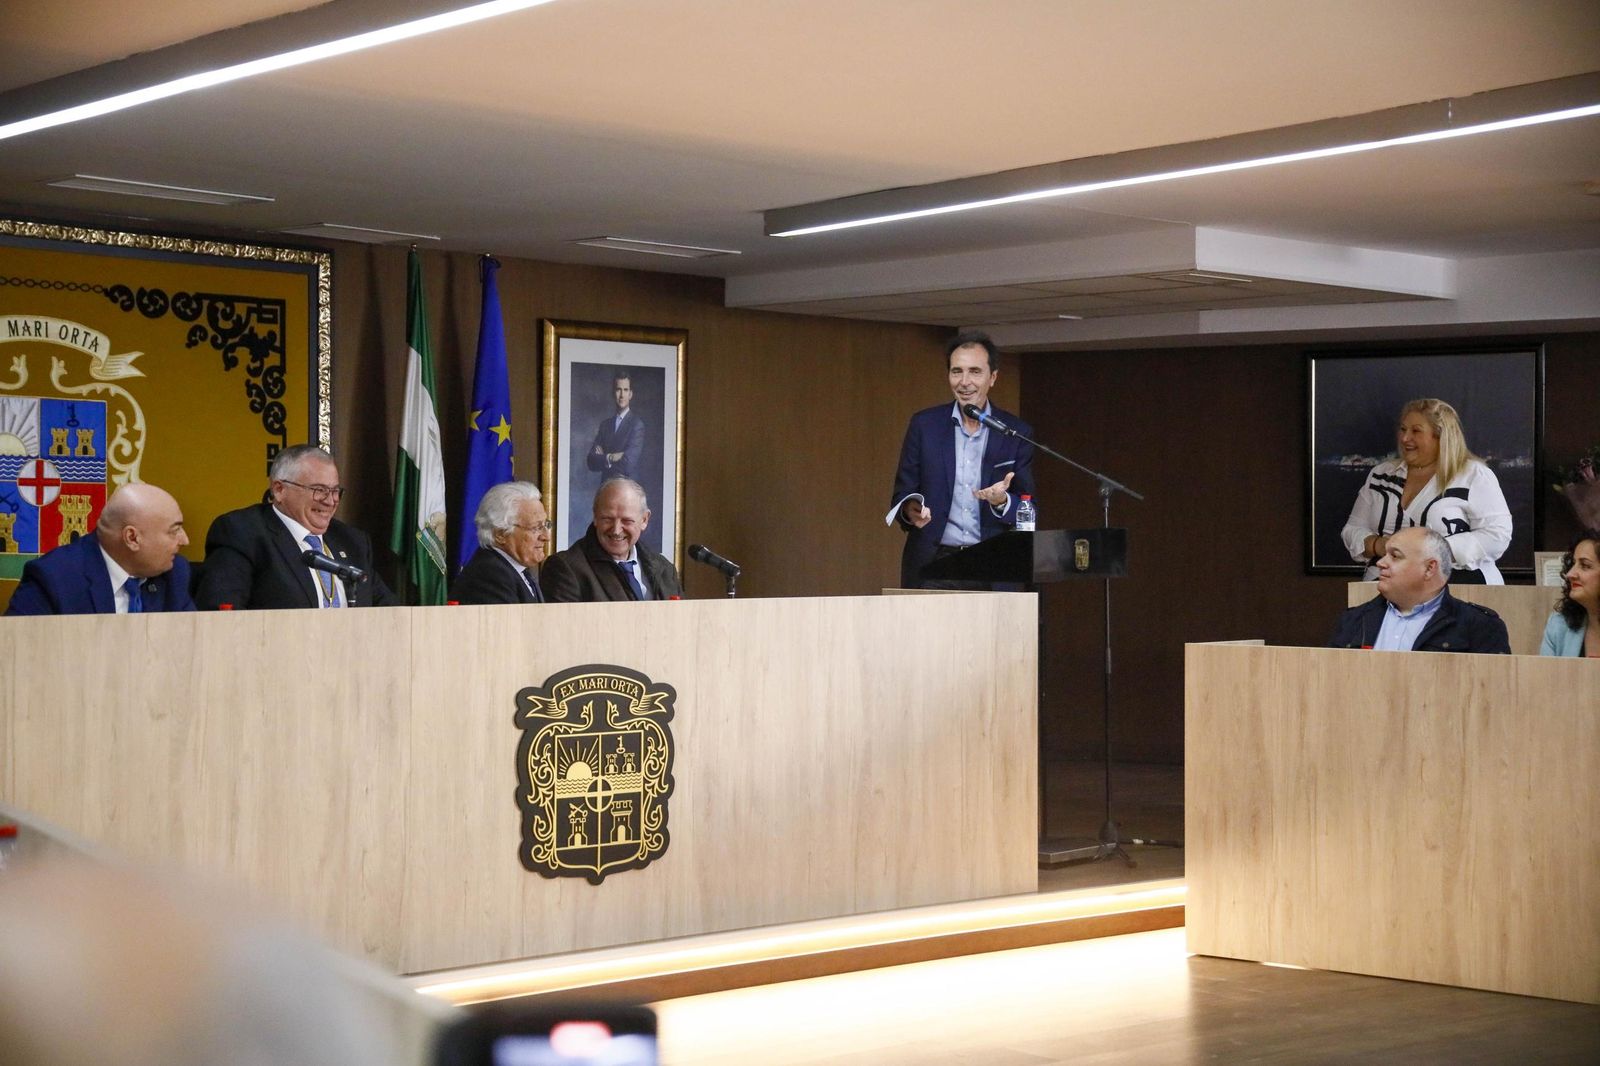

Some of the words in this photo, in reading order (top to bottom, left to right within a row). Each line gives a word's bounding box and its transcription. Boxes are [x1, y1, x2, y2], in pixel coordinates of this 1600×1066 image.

[7, 319, 49, 338] MARI
[58, 324, 99, 353] ORTA
[560, 683, 576, 698] EX
[578, 678, 607, 690] MARI
[610, 678, 639, 698] ORTA
